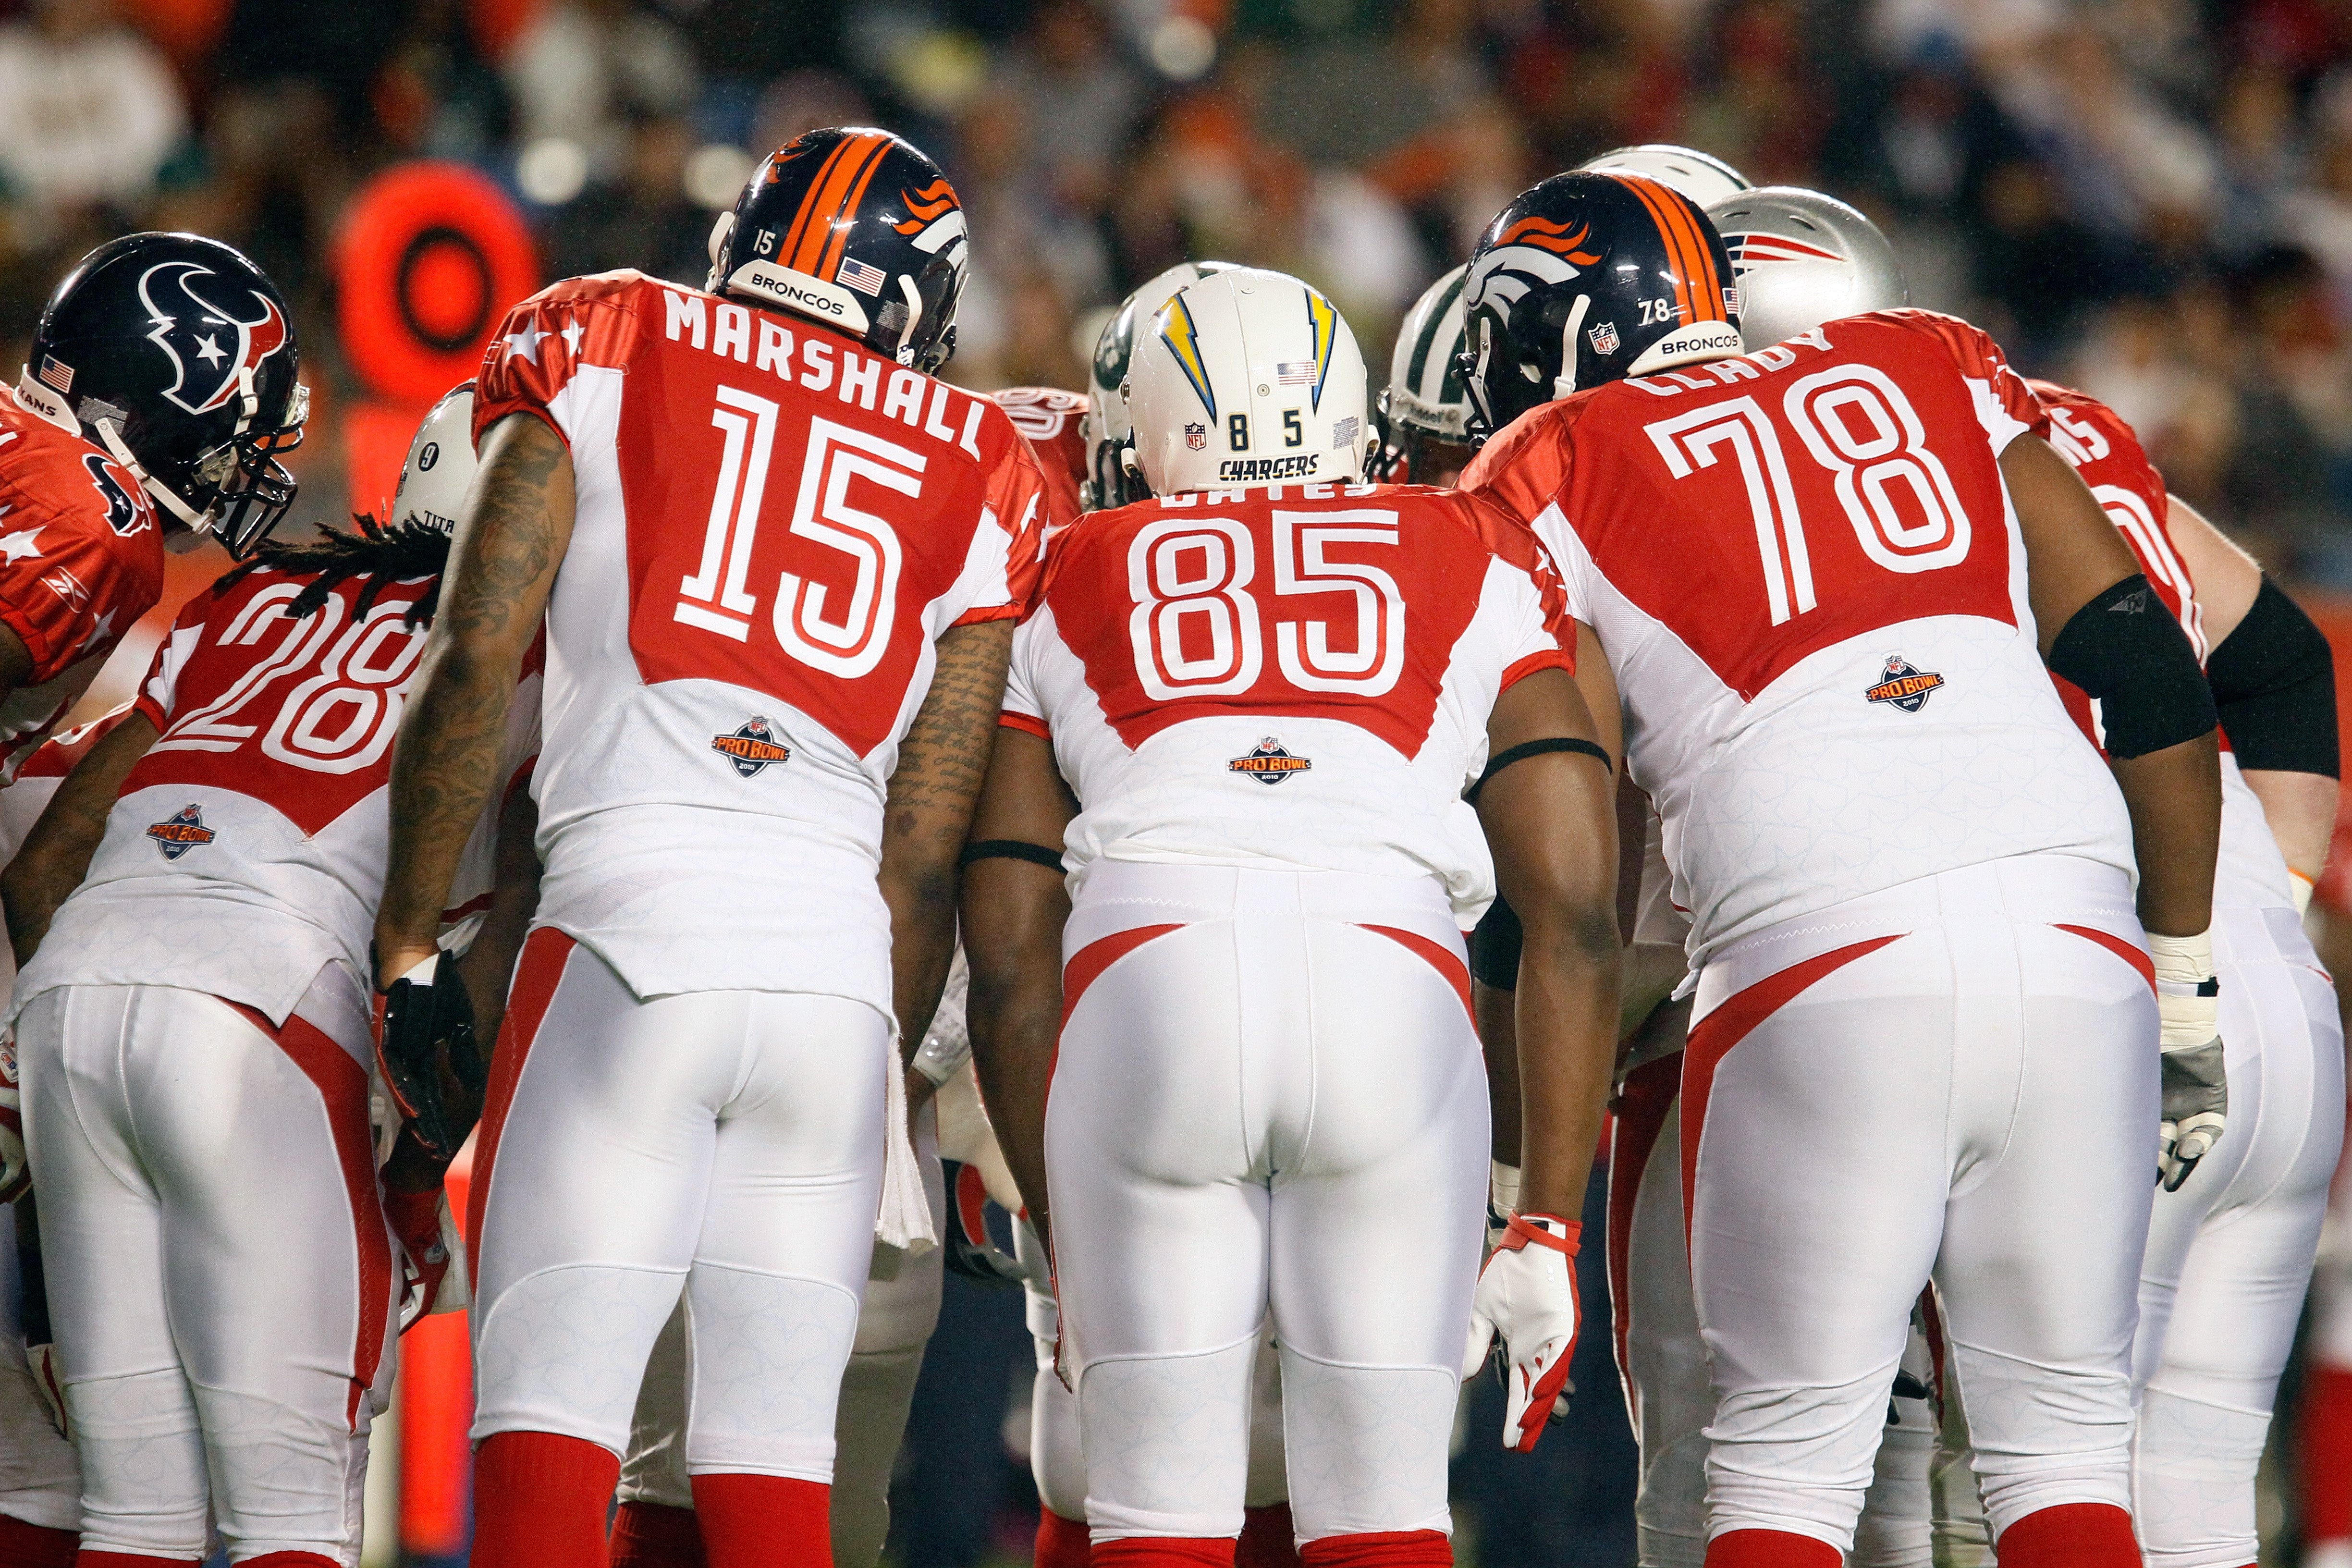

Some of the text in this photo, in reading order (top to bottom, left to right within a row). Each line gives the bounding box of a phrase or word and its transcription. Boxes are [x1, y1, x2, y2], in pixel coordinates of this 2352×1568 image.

[753, 229, 776, 255] 15
[751, 273, 845, 316] BRONCOS
[1637, 298, 1671, 327] 78
[1595, 335, 1617, 351] NFL
[1662, 335, 1738, 355] BRONCOS
[663, 289, 985, 463] MARSHALL
[1187, 434, 1205, 445] NFL
[1219, 453, 1320, 481] CHARGERS
[1643, 363, 1972, 627] 78
[674, 385, 928, 679] 15
[1127, 509, 1406, 701] 85
[143, 582, 435, 775] 28
[1870, 675, 1940, 700] PRO BOWL
[1902, 698, 1920, 707] 2010
[716, 737, 786, 760] PRO BOWL
[739, 762, 755, 771] 2010
[1234, 758, 1308, 771] PRO BOWL
[151, 825, 210, 842] PRO BOWL
